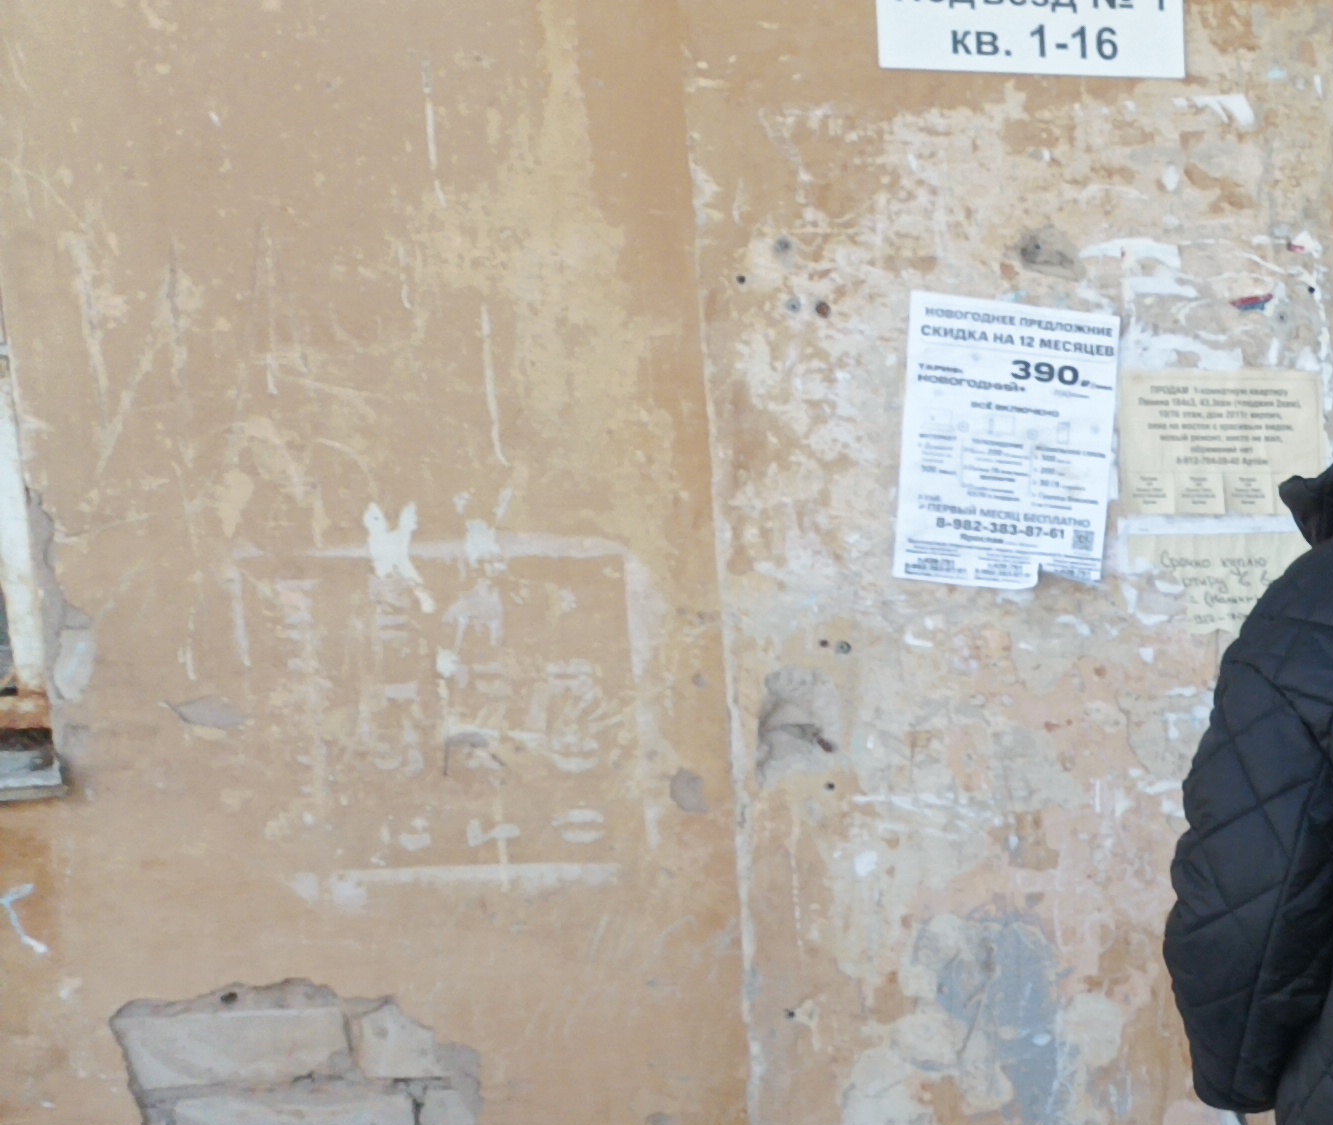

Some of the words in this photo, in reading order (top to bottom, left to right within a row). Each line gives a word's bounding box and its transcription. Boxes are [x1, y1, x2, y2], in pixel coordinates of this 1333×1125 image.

[950, 29, 1012, 57] кв.
[1030, 24, 1119, 60] 1-16
[925, 306, 1015, 326] НОВОГОДНЕЕ
[920, 324, 989, 342] СКИДКА
[993, 333, 1015, 346] НА
[1020, 335, 1035, 348] 12
[1039, 338, 1115, 357] МЕСЯЦЕВ
[1010, 359, 1079, 386] 390
[936, 517, 1065, 539] 8-982-383-87-61
[979, 508, 1021, 522] МЕСЯЦ
[1023, 513, 1091, 528] БЕСПЛАТНО
